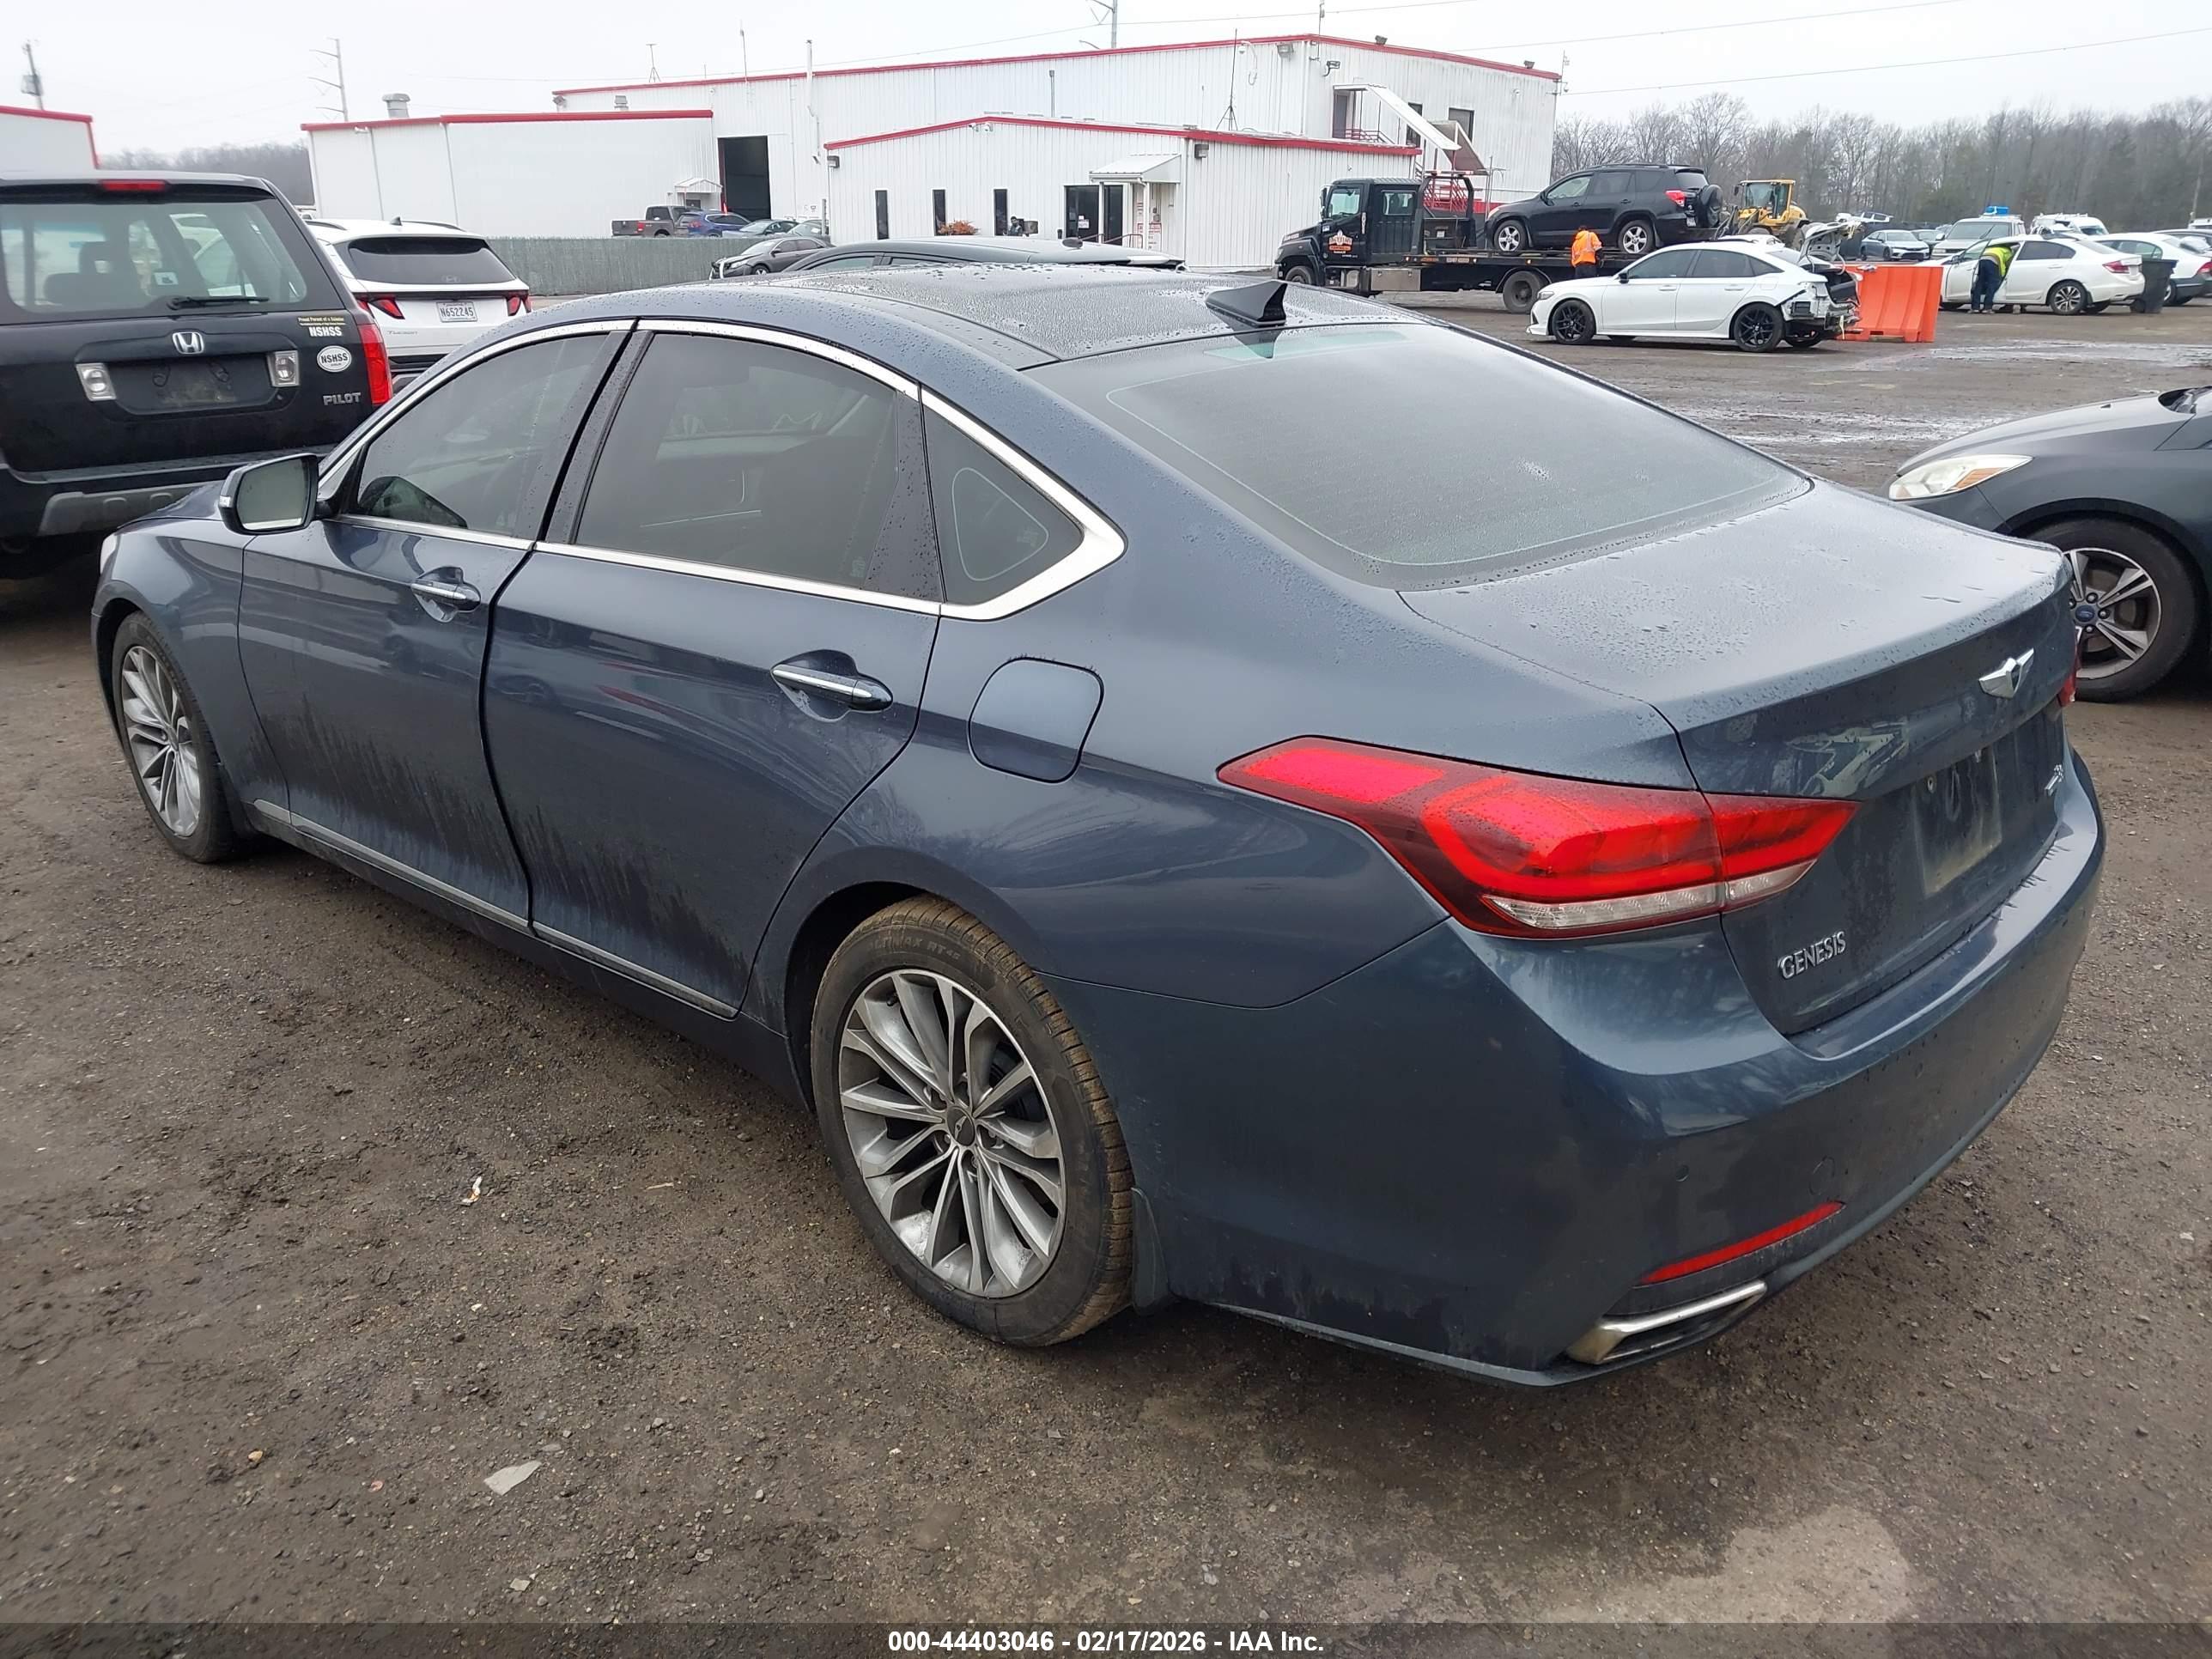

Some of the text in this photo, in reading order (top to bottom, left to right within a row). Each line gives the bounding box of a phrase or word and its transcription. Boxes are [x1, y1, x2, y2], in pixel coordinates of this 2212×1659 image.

[440, 307, 475, 318] N652245
[309, 326, 343, 337] NSHSS
[320, 353, 349, 364] NSHSS
[323, 392, 362, 406] PILOT
[1778, 930, 1846, 979] GENESIS
